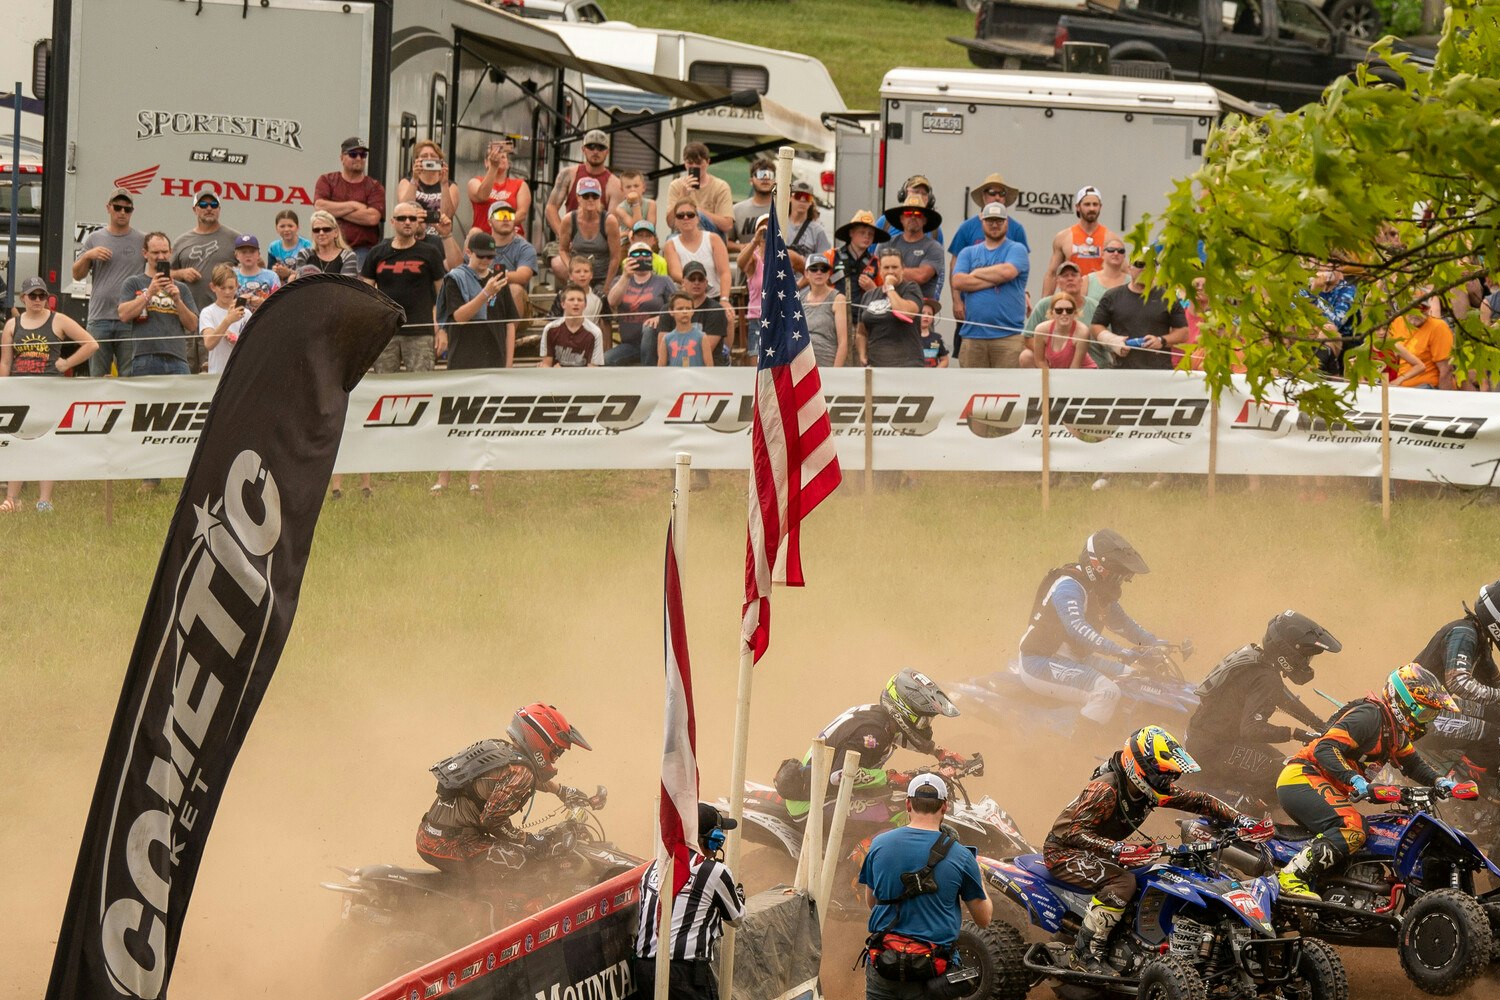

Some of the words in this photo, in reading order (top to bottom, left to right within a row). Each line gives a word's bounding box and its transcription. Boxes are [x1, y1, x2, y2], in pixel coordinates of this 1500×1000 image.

[136, 110, 304, 151] SPORTSTER
[193, 152, 210, 161] EST.
[211, 148, 227, 158] KZ
[228, 154, 244, 163] 1972
[161, 177, 315, 206] HONDA
[1016, 191, 1075, 210] LOGAN
[447, 427, 547, 438] Performance
[551, 426, 620, 437] Products
[848, 426, 916, 437] Prducts
[1128, 430, 1193, 440] Products
[1397, 436, 1465, 450] Products
